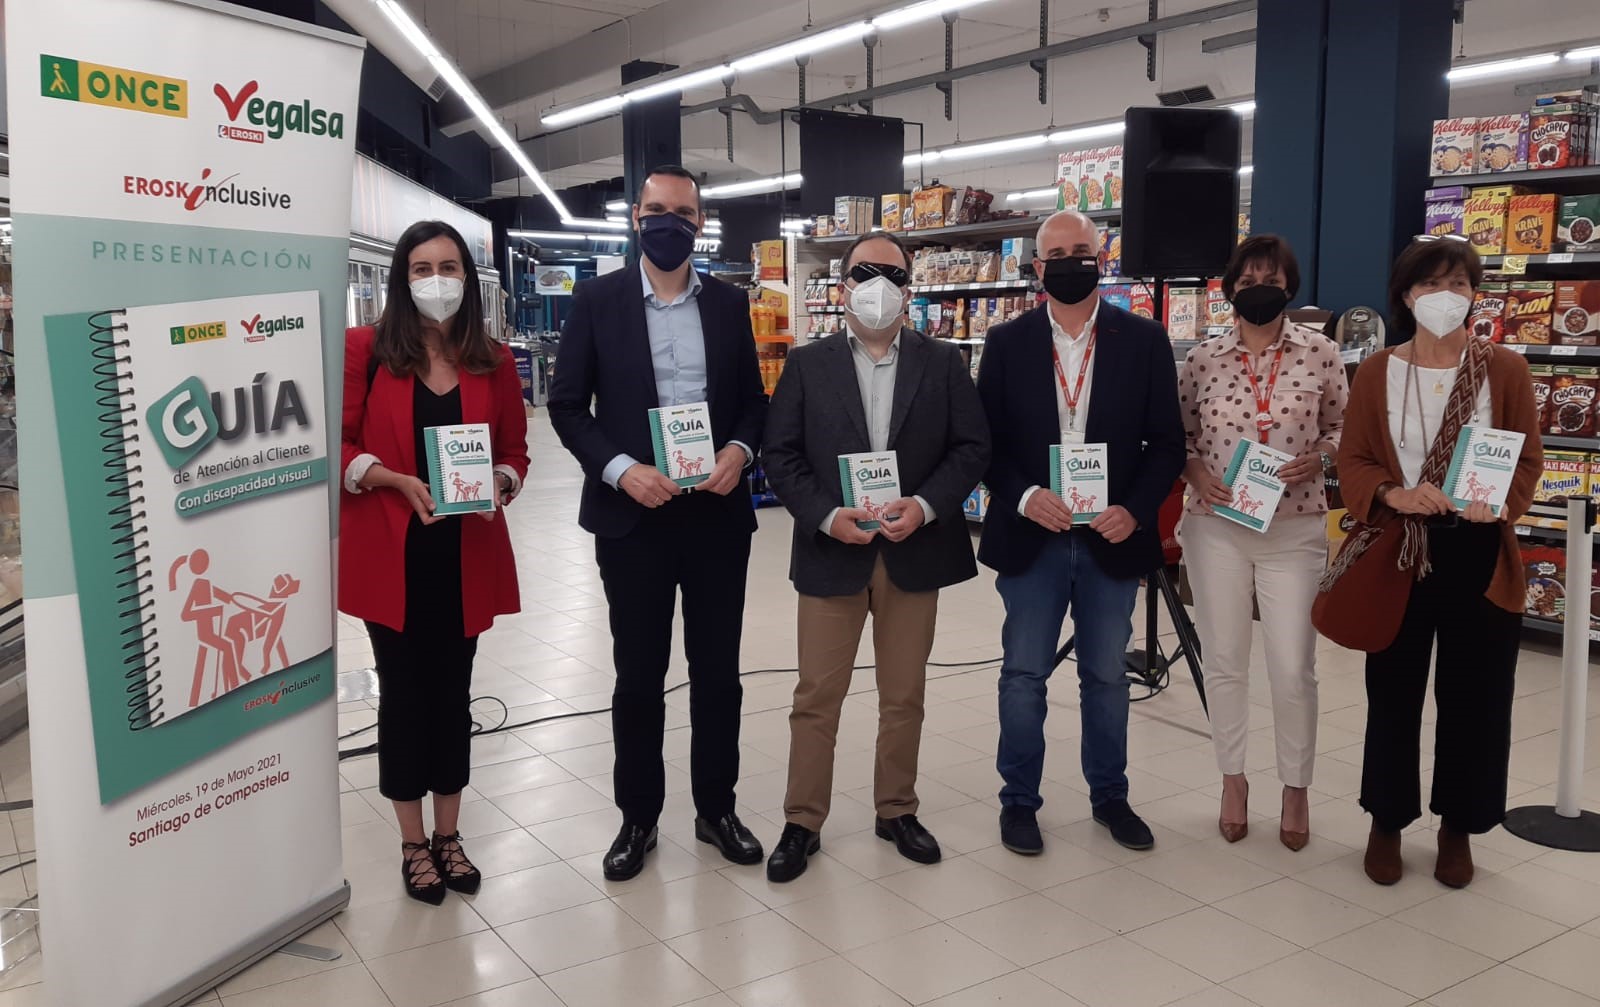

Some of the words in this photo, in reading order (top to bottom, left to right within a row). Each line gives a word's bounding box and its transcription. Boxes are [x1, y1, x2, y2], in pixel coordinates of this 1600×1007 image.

[87, 70, 181, 111] ONCE
[213, 80, 344, 140] Vegalsa
[231, 128, 263, 142] EROSKI
[1531, 121, 1569, 142] CHOCAPIC
[1430, 221, 1456, 235] KRAVE
[1468, 218, 1495, 235] KRAVE
[1514, 216, 1544, 232] KRAVE
[92, 240, 313, 271] PRESENTACIÓN
[1517, 295, 1553, 316] LION
[187, 324, 224, 341] ONCE
[240, 314, 305, 337] Vegalsa
[1553, 386, 1594, 403] CHOCAPIC
[162, 372, 308, 449] GUÍA
[669, 418, 704, 435] GUÍA
[447, 439, 484, 454] GUÍA
[1475, 442, 1511, 460] GUÍA
[173, 470, 190, 485] de
[197, 456, 249, 479] Atención
[252, 450, 263, 465] al
[267, 444, 310, 462] Cliente
[1068, 457, 1101, 472] GUÍA
[859, 467, 892, 481] GUÍA
[1542, 475, 1581, 491] Nesquik
[178, 495, 201, 510] Con
[204, 473, 276, 504] discapacidad
[279, 465, 311, 485] visual
[137, 792, 193, 822] Miércoles,
[195, 783, 208, 797] 19
[211, 777, 225, 791] de
[228, 765, 254, 785] Mayo
[257, 753, 281, 772] 2021
[129, 812, 190, 847] Santiago
[194, 803, 211, 819] de
[215, 771, 290, 809] Compostela
